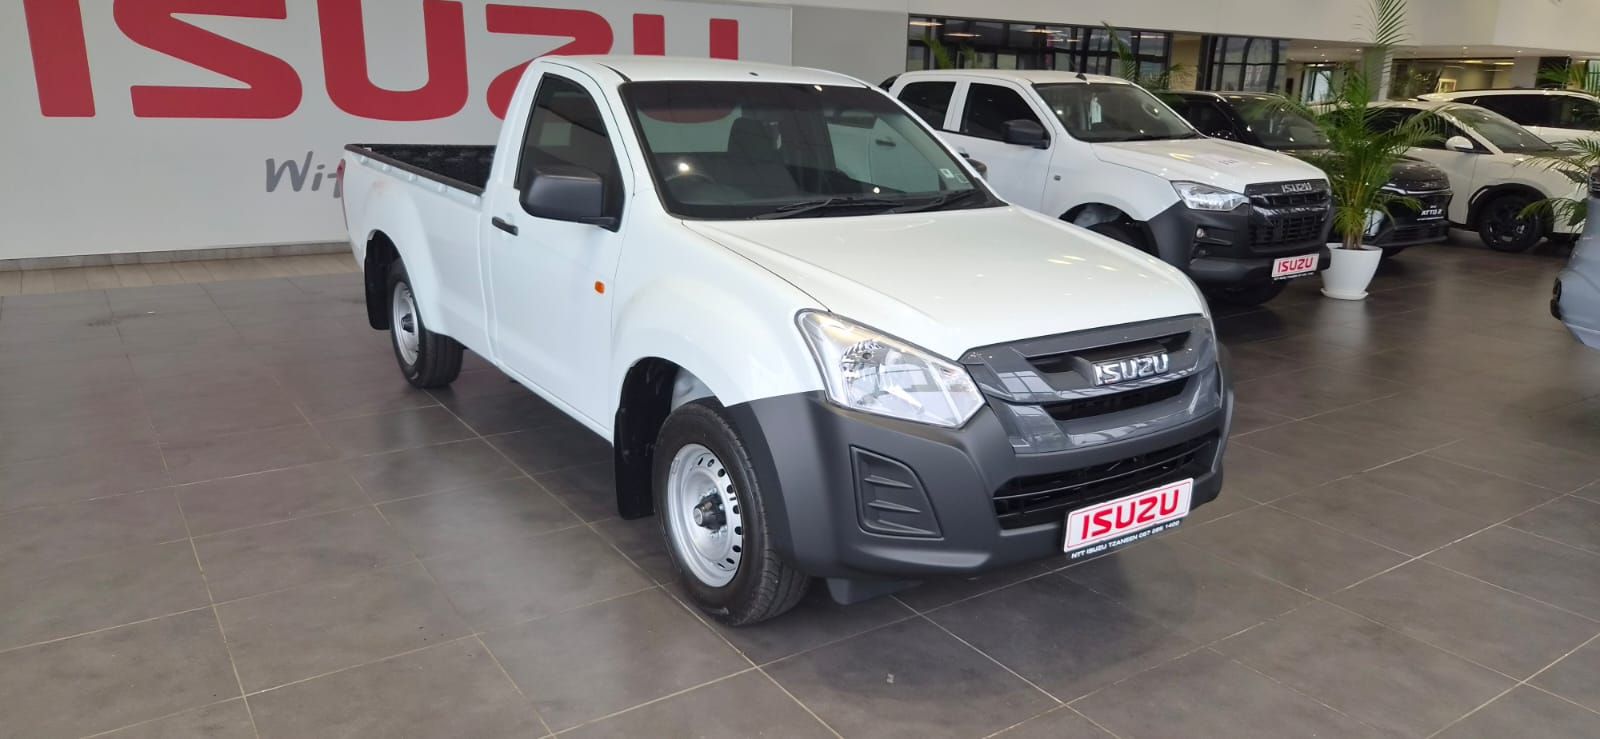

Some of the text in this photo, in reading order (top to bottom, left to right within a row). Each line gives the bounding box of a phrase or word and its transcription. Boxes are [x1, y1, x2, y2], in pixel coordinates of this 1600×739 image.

[1281, 182, 1312, 193] ISUZU
[1277, 257, 1313, 272] ISUZU
[1094, 353, 1169, 386] ISUZU
[1081, 490, 1179, 539] ISUZU
[1071, 550, 1085, 559] NTT
[1086, 544, 1107, 554] ISUZU
